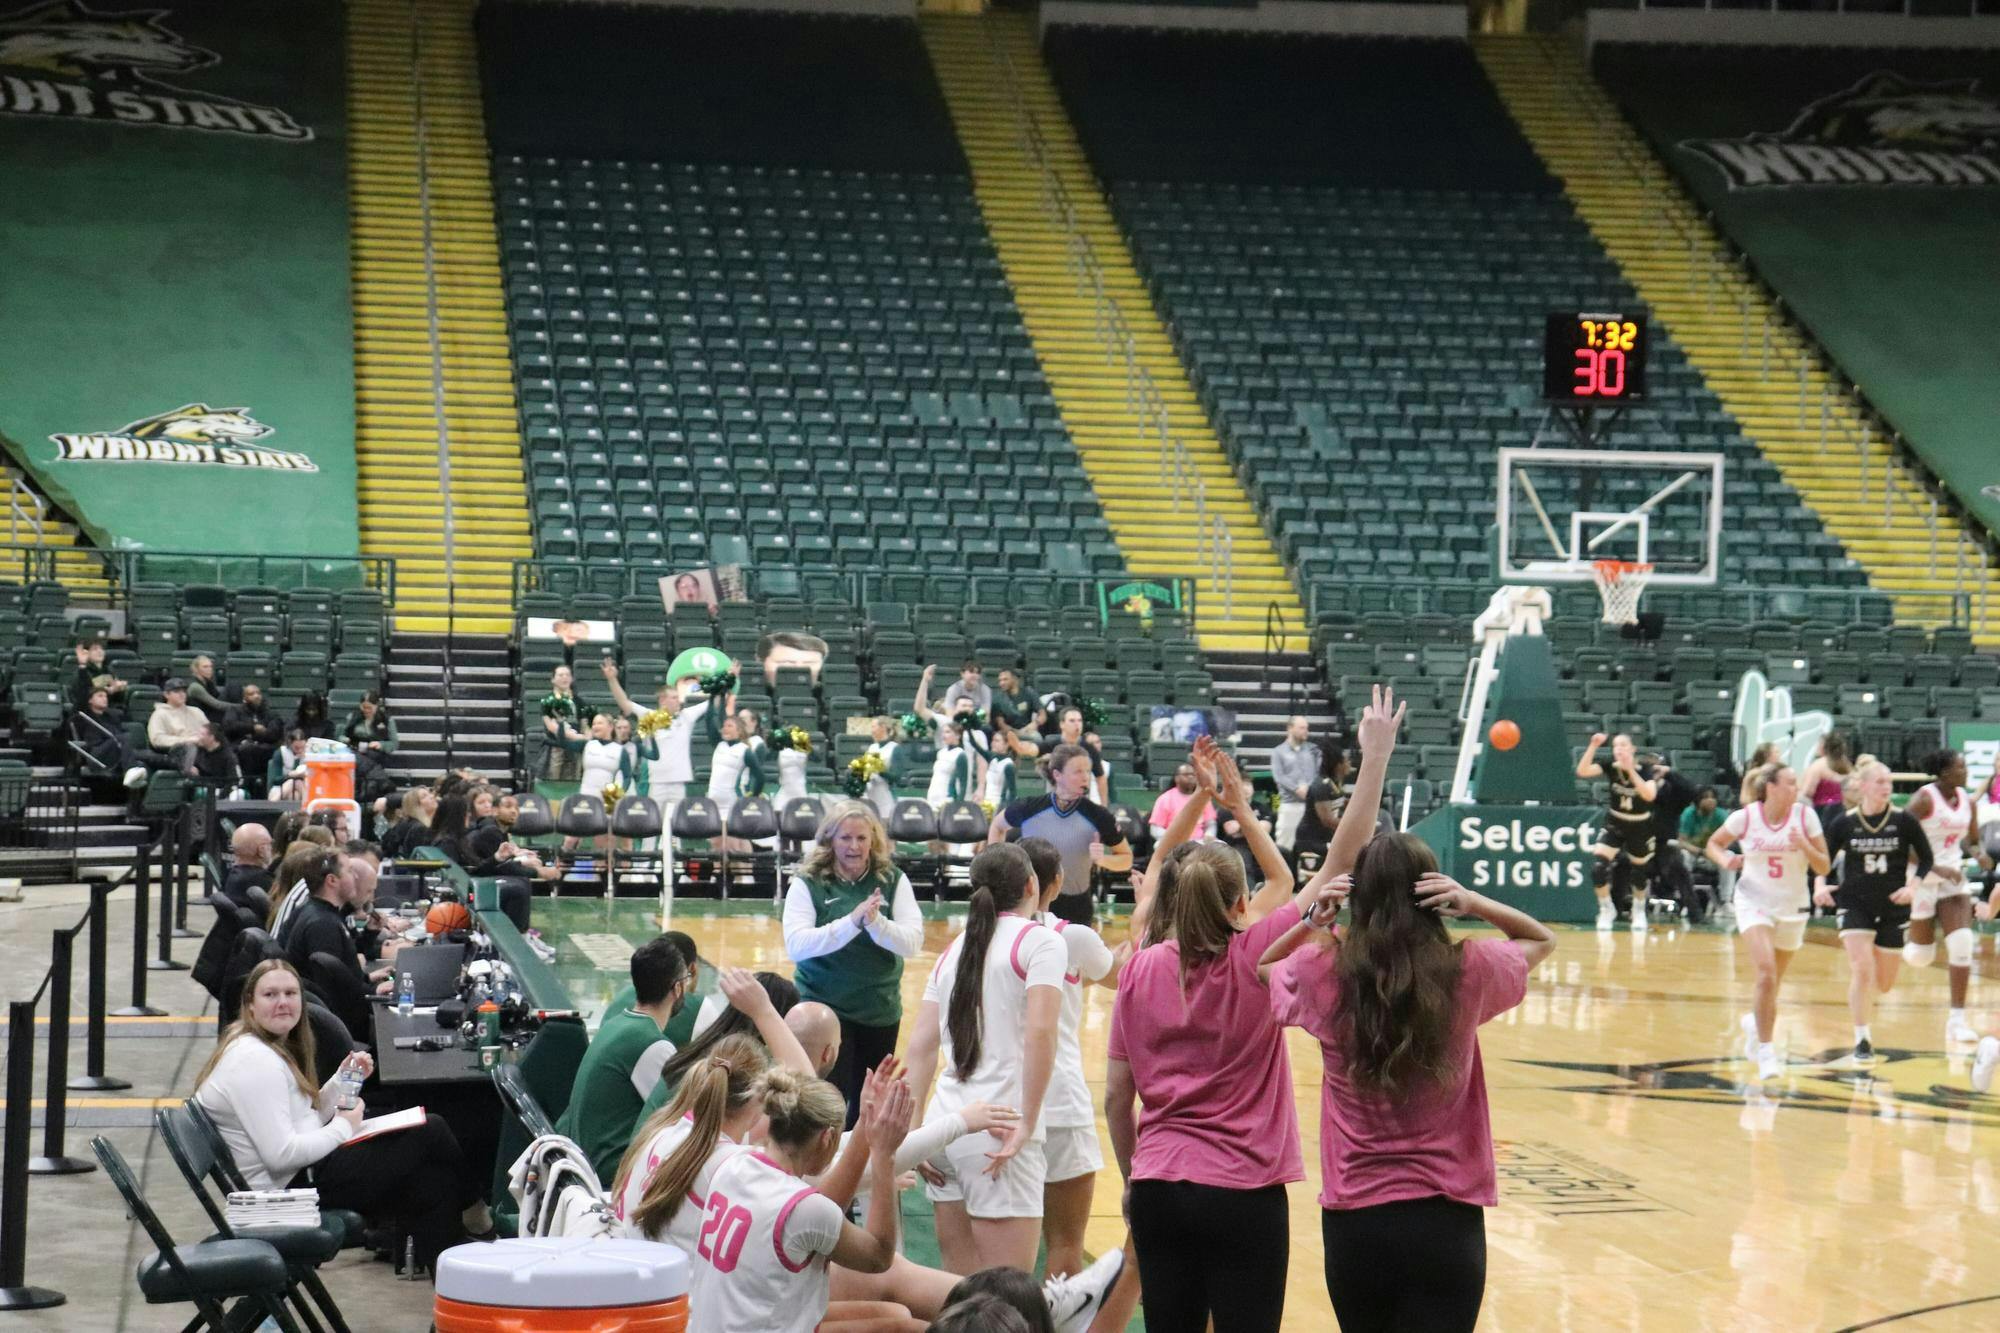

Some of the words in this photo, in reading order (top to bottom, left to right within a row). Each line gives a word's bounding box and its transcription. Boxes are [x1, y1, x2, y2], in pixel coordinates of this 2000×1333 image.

[107, 90, 307, 138] STATE
[1581, 320, 1638, 351] 7:32
[1574, 348, 1625, 396] 30
[66, 435, 217, 462] WRIGHT
[220, 448, 314, 470] STATE
[699, 654, 712, 668] L
[1460, 816, 1597, 853] Select
[1472, 859, 1584, 888] SIGNS
[1767, 856, 1784, 879] 5
[1864, 853, 1888, 875] 54
[697, 1191, 753, 1274] 20
